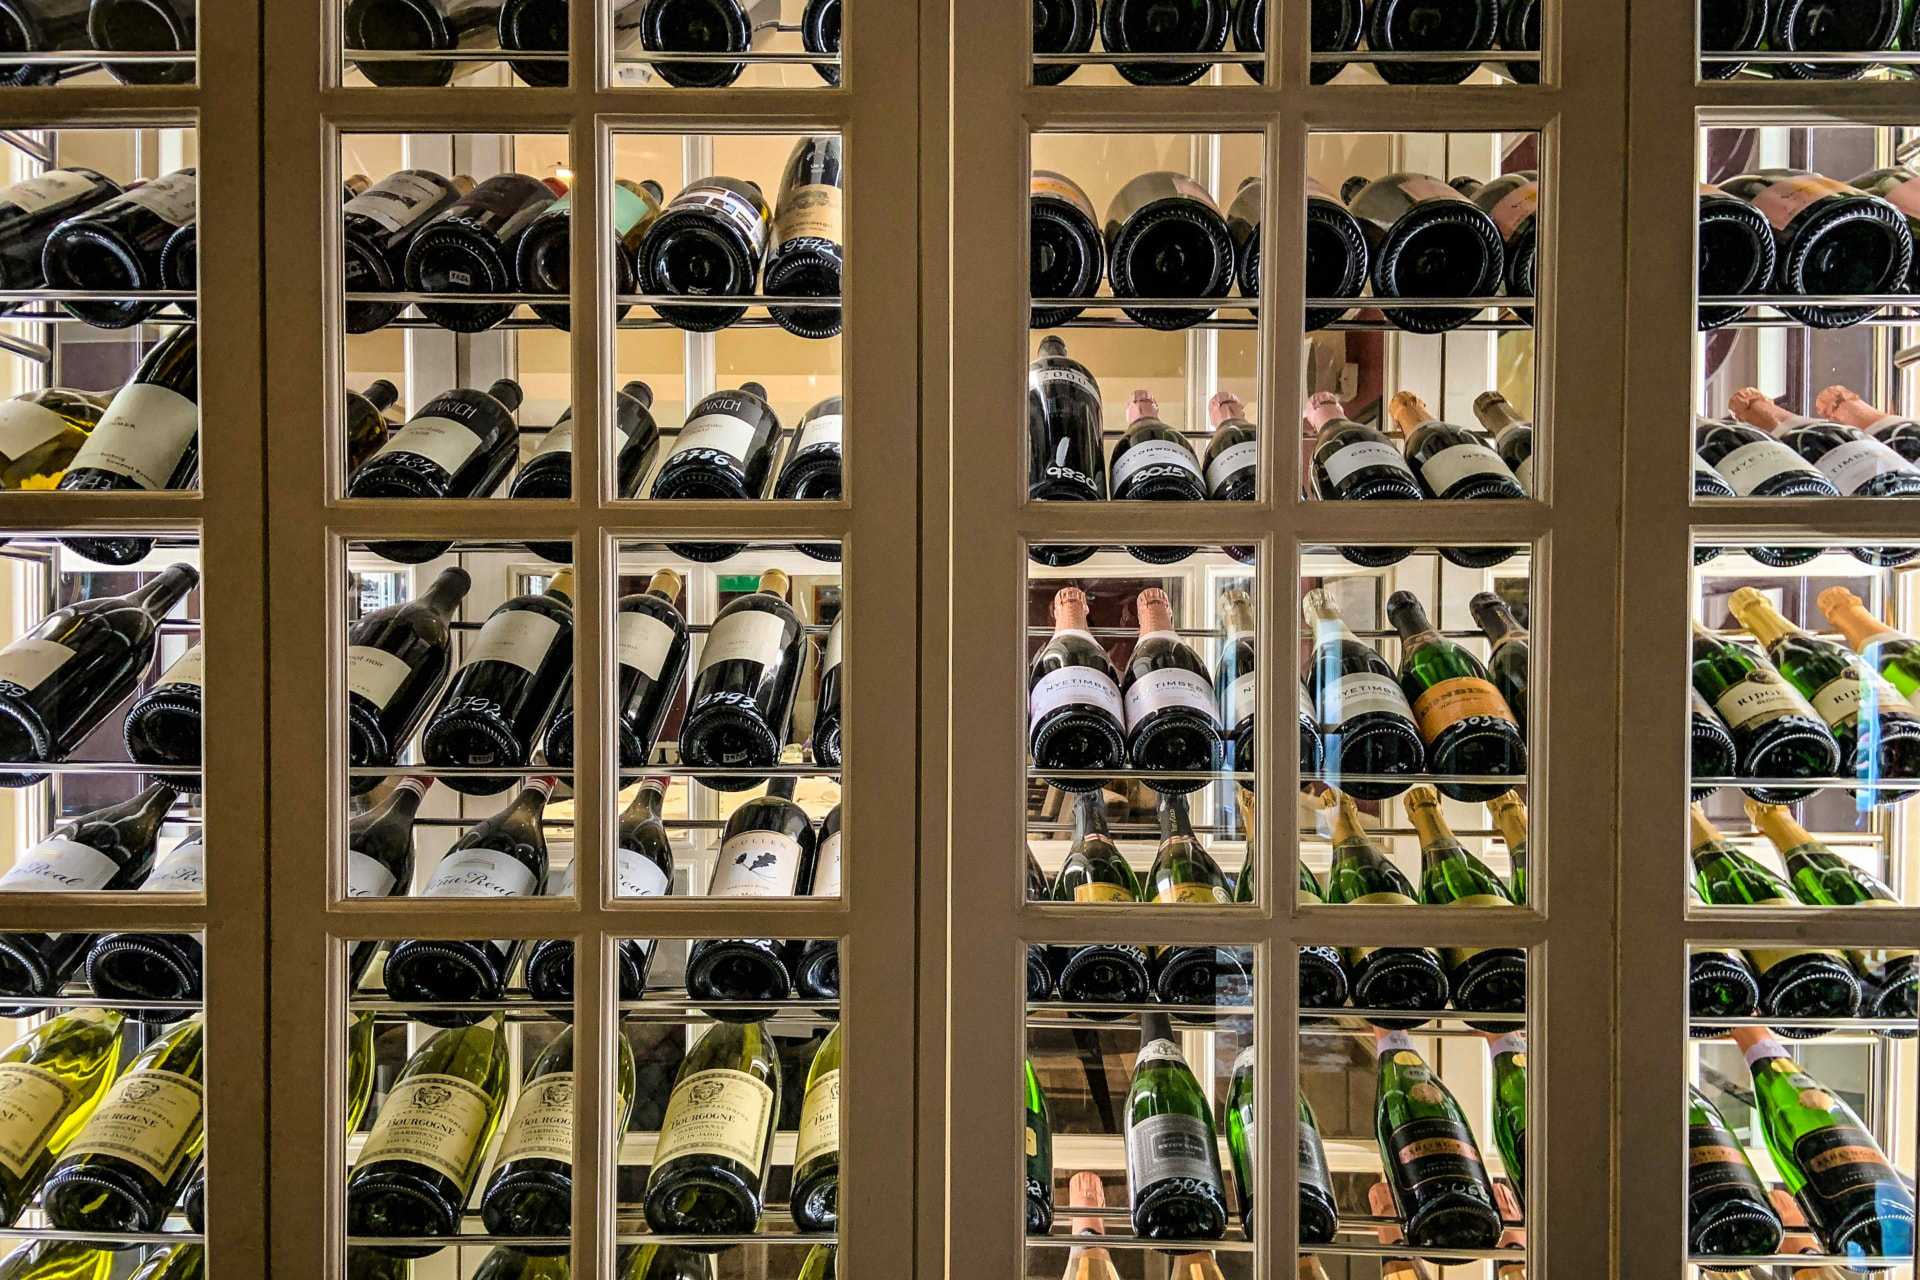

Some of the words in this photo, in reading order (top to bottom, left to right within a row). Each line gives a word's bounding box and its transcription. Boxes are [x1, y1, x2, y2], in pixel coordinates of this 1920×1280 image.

[1043, 371, 1086, 386] 2000
[672, 449, 730, 466] 9786
[1350, 447, 1398, 459] COTTON
[1046, 466, 1098, 491] 9830
[349, 654, 364, 663] not
[1046, 678, 1116, 698] NYETIMBER
[1132, 681, 1203, 703] NTIMBER
[731, 838, 788, 849] CULLEN
[24, 861, 85, 886] Real
[171, 866, 203, 884] Re
[464, 871, 518, 896] Real
[619, 875, 652, 896] eal
[671, 1111, 736, 1130] BOURGOGNE
[711, 1103, 749, 1122] JACOBINS
[387, 1117, 456, 1136] BOURGOGNE
[434, 1110, 469, 1137] JACOBINS
[520, 1116, 572, 1129] BOURGOG
[521, 1128, 570, 1137] CHARDONNA
